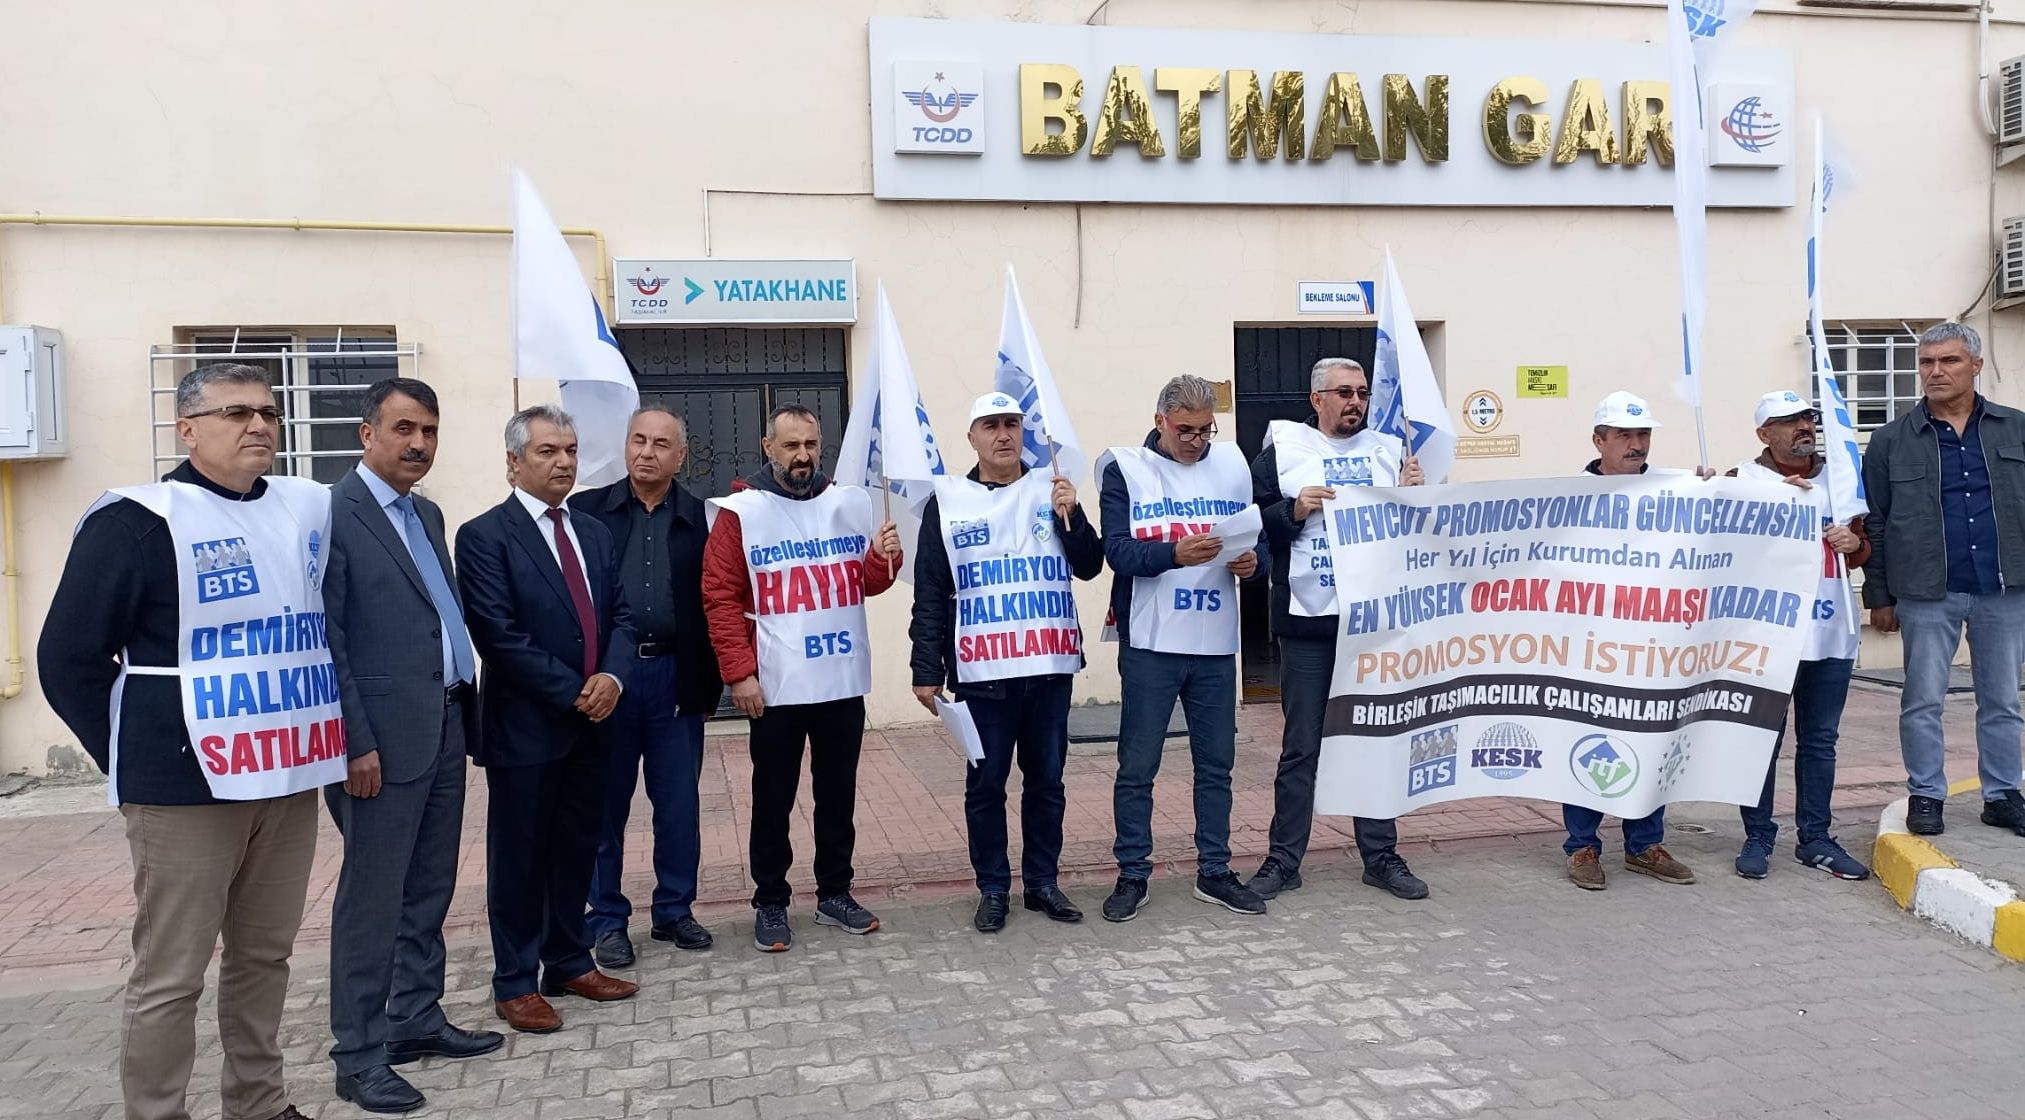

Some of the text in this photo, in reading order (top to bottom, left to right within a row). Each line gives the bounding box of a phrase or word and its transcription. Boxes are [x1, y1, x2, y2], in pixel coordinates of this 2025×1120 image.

[1683, 6, 1727, 37] SK
[1018, 63, 1450, 162] BATMAN
[912, 127, 973, 143] TCDD
[631, 299, 668, 307] TCDD
[713, 279, 847, 301] YATAKHANE
[1305, 293, 1360, 302] BEKLEME SALONU
[1334, 490, 1816, 546] MEVCUT PROMOSYONLAR GÜNCELLENSİN!
[750, 534, 866, 567] özelleştirmeye
[957, 530, 987, 547] BTS
[1406, 541, 1733, 571] Her Yıl İçin Kurumdan Alınan
[204, 570, 252, 598] BTS
[756, 560, 865, 616] HAYIR
[1173, 588, 1221, 612] BTS
[1347, 578, 1801, 636] EN YÜKSEK OCAK AYI MAAŞI KADAR
[1811, 600, 1835, 620] TS
[804, 630, 852, 659] BTS
[959, 628, 1080, 663] SATILAMAZ
[1356, 630, 1770, 684] PROMOSYON İSTİYORUZ!
[192, 662, 338, 720] HALKIND
[1352, 684, 1753, 726] BİRLEŞİK TAŞIMACILIK ÇALIŞANLARI SENDİKASI
[1471, 748, 1543, 768] KESK
[1412, 761, 1450, 791] BTS
